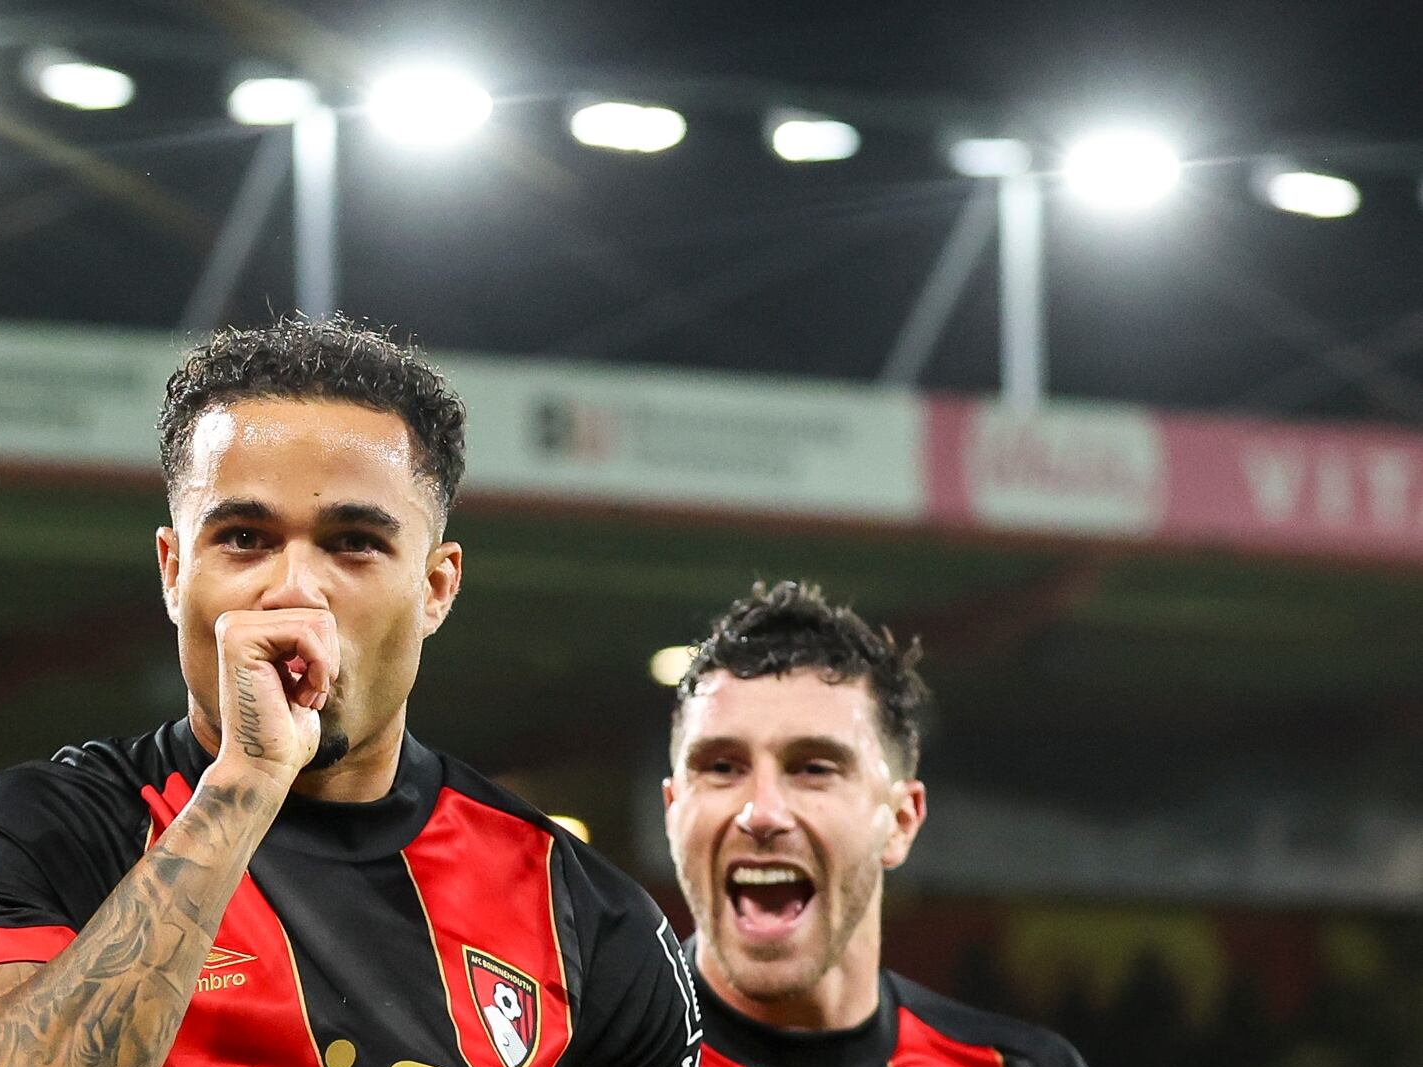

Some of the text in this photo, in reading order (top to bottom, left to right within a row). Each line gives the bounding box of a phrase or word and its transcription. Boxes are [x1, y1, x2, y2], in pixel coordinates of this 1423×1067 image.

[196, 972, 247, 993] mbro
[471, 955, 532, 993] AFC BOURNEMOUTH
